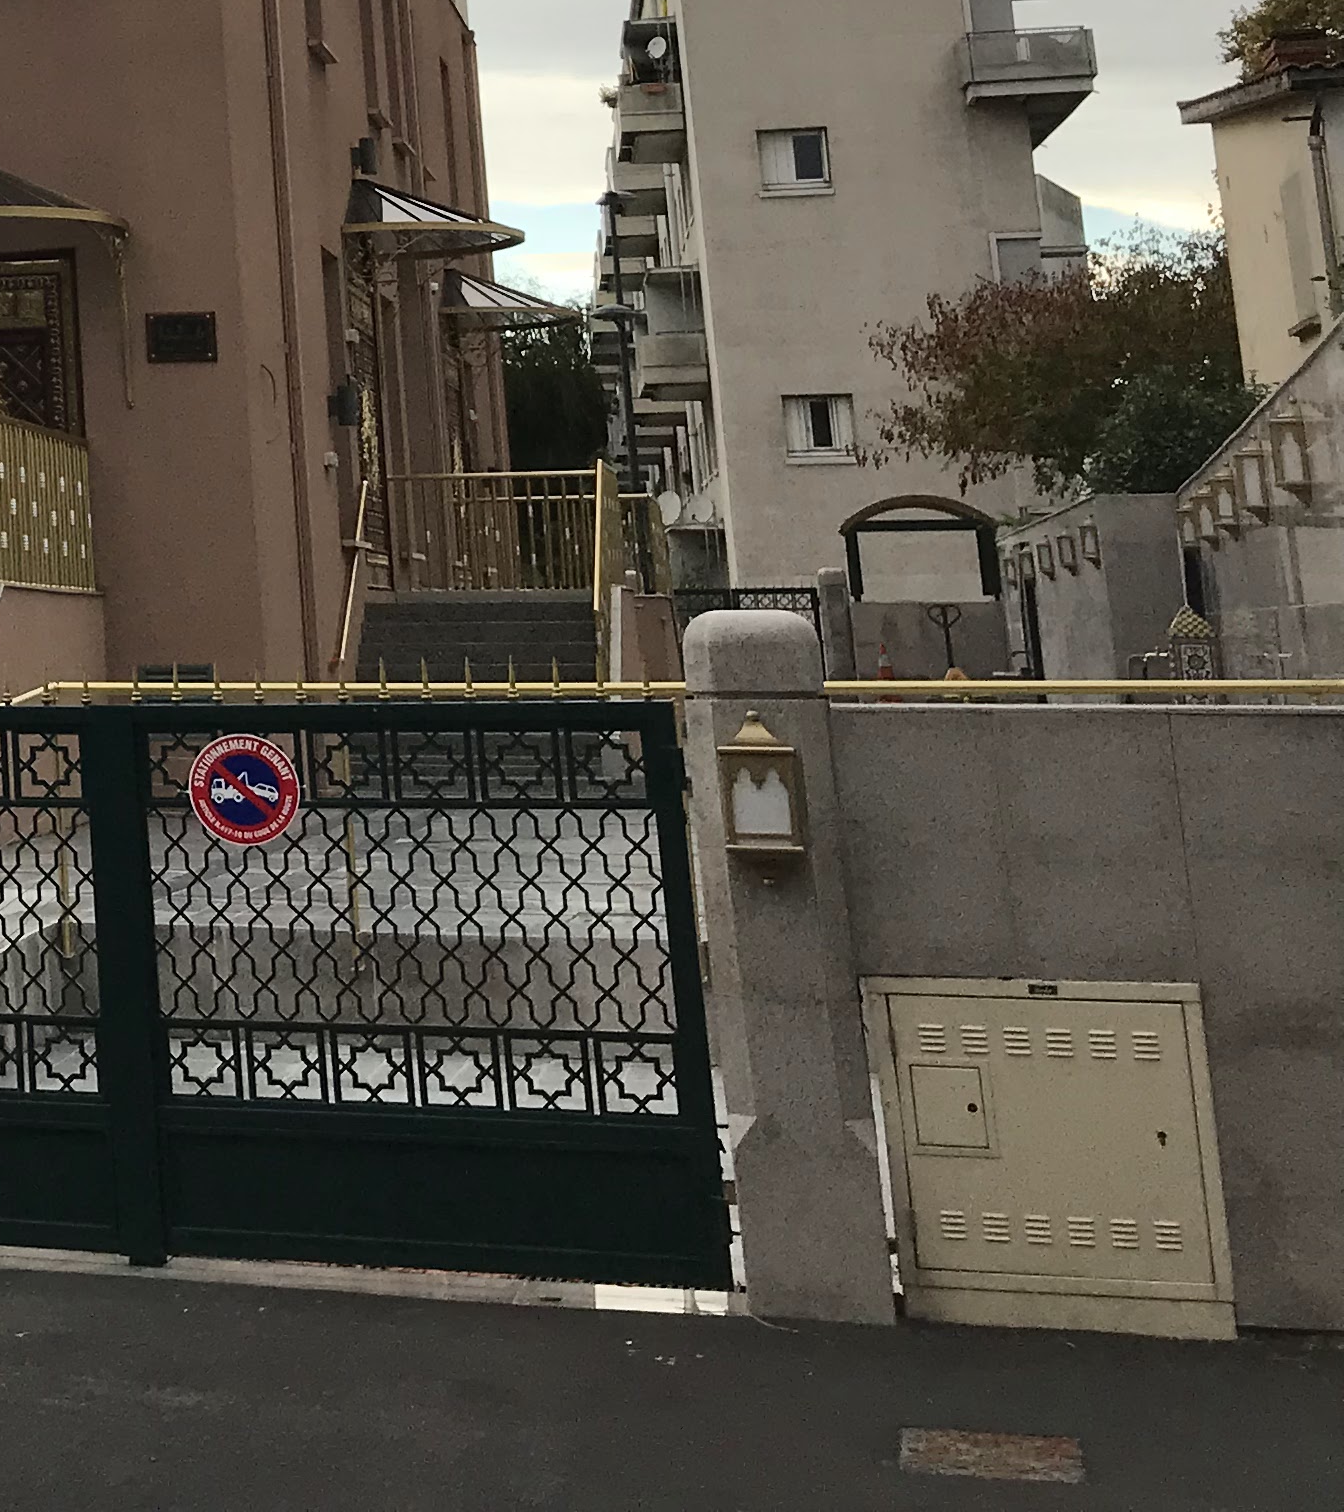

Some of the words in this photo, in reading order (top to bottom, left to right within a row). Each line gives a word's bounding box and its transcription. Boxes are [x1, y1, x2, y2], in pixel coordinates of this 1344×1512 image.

[193, 739, 260, 787] STATIONNEMENT
[260, 745, 293, 781] GENANT
[276, 814, 286, 824] LA
